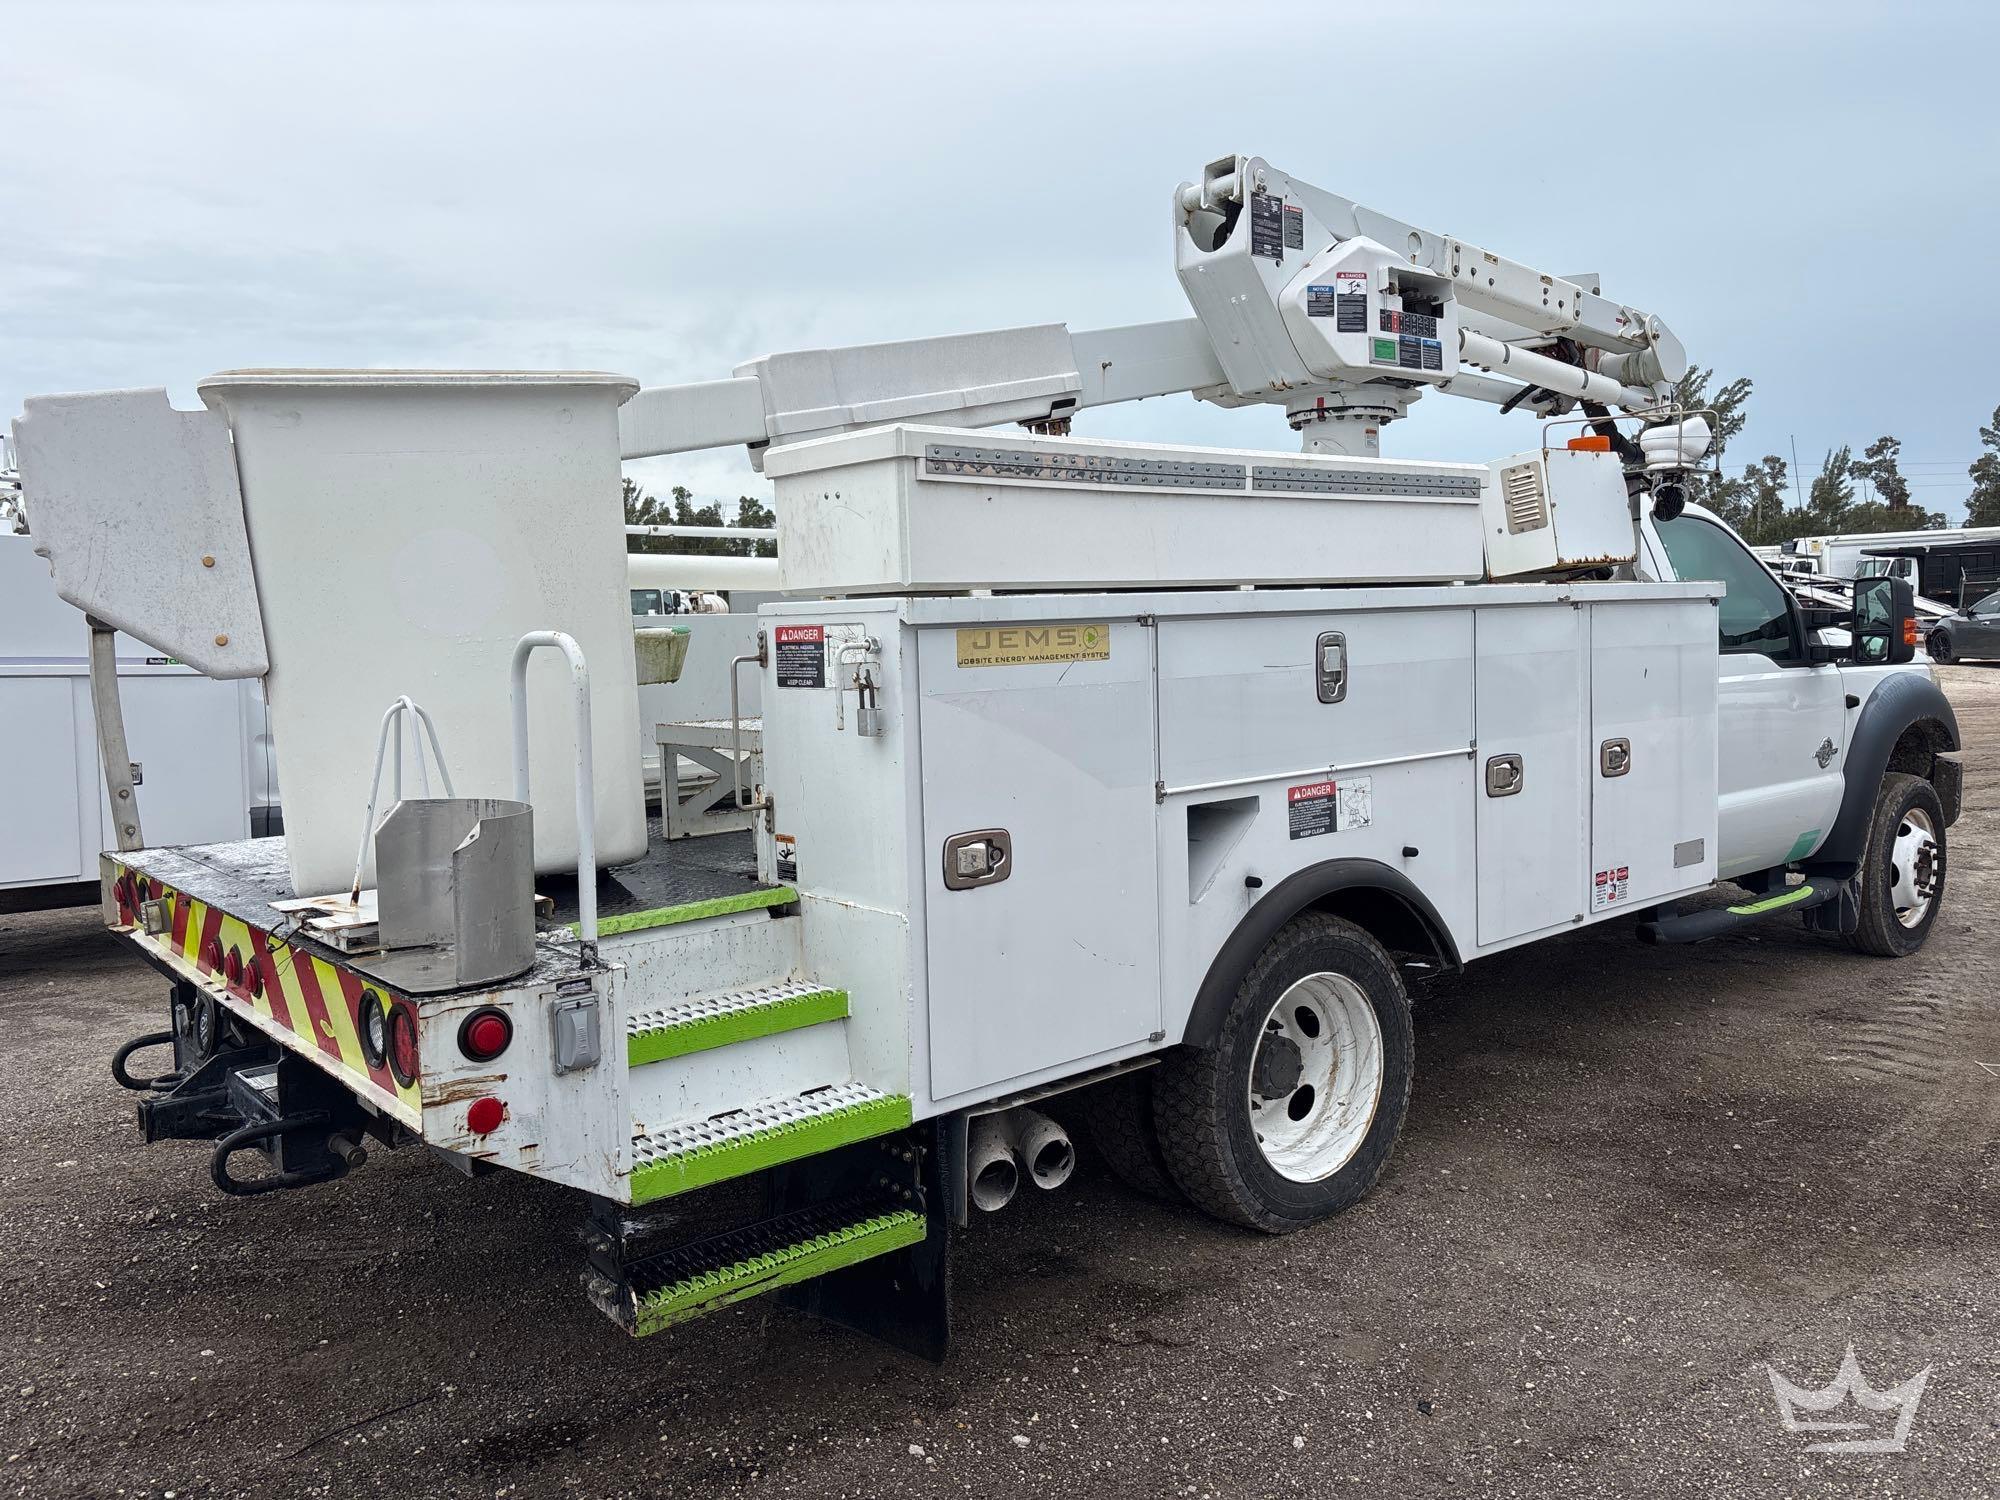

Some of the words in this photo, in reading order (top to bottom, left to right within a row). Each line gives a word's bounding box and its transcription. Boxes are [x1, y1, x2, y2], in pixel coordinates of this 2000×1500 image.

[788, 629, 819, 640] DANGER
[959, 657, 992, 665] JOBSITE
[1028, 653, 1080, 661] MANAGEMENT
[1082, 651, 1109, 659] SYSTEM
[1302, 785, 1331, 797] DANGER
